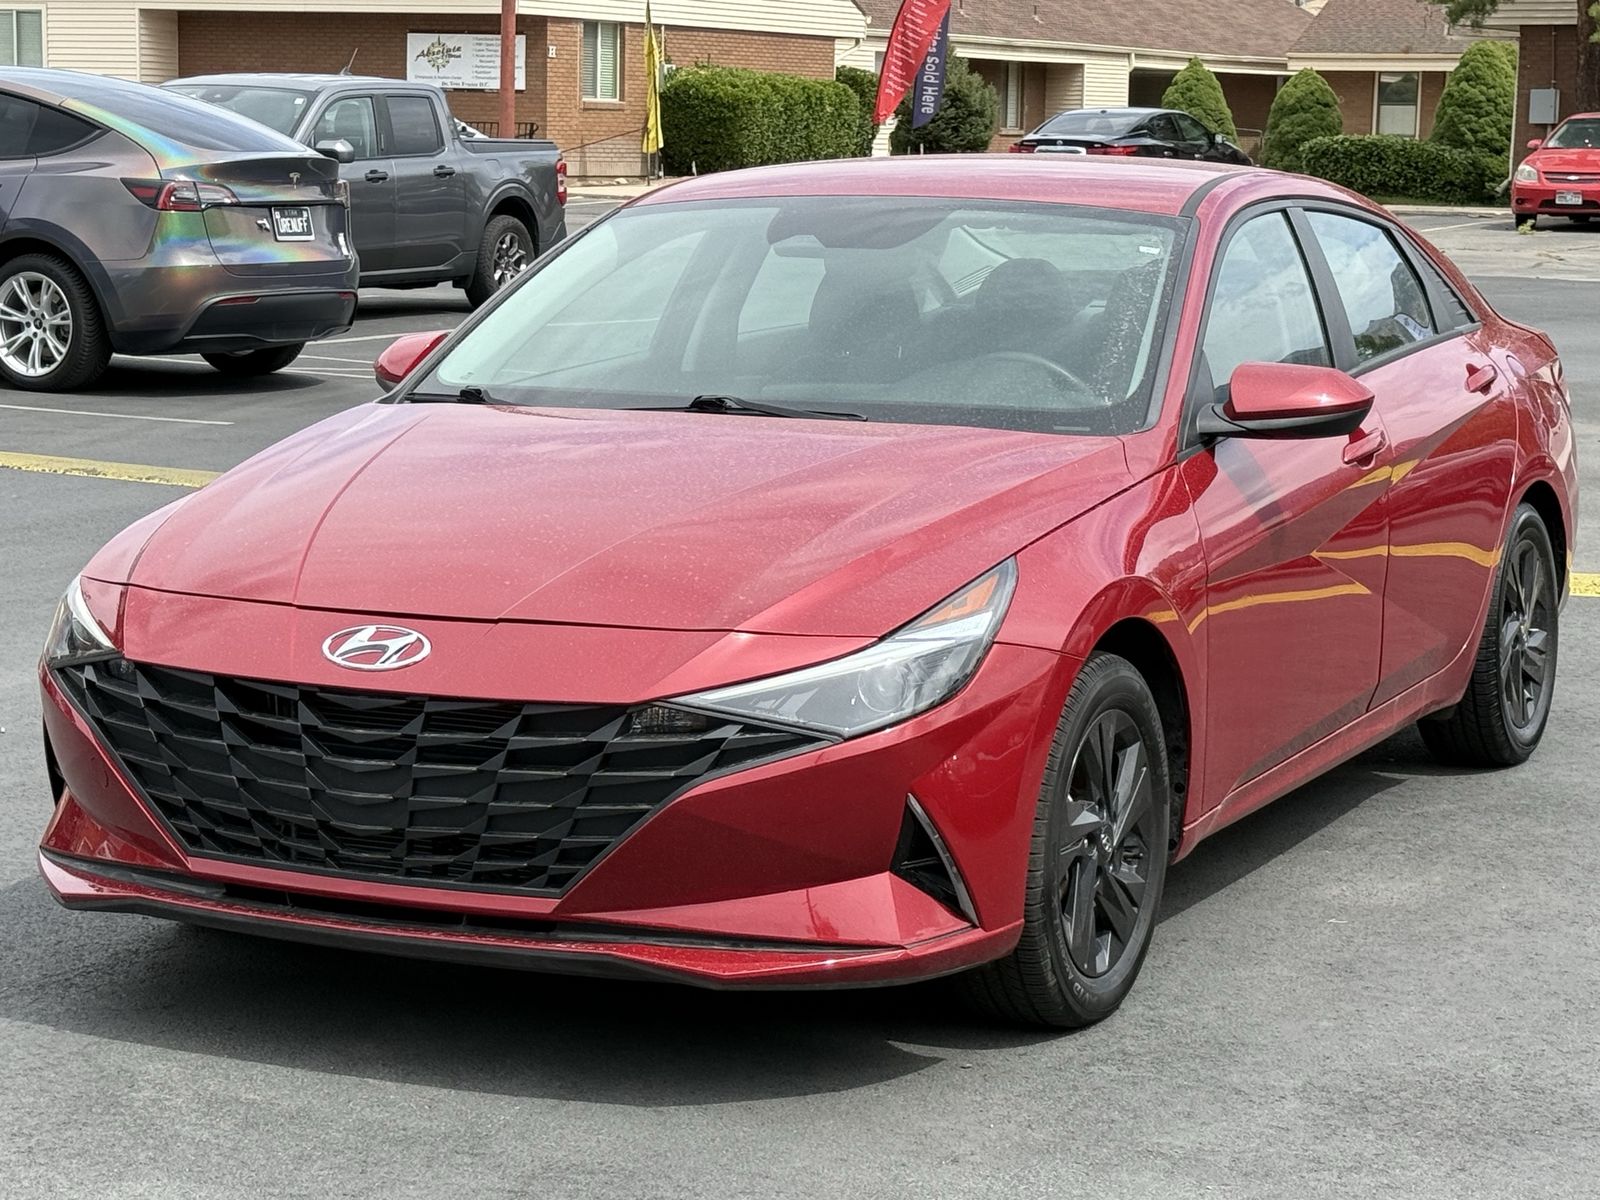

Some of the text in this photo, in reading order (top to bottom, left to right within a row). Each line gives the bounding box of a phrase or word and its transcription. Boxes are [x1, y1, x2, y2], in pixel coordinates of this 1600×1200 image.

[414, 45, 462, 62] Absolute
[922, 56, 940, 83] Sold
[921, 86, 939, 114] Here
